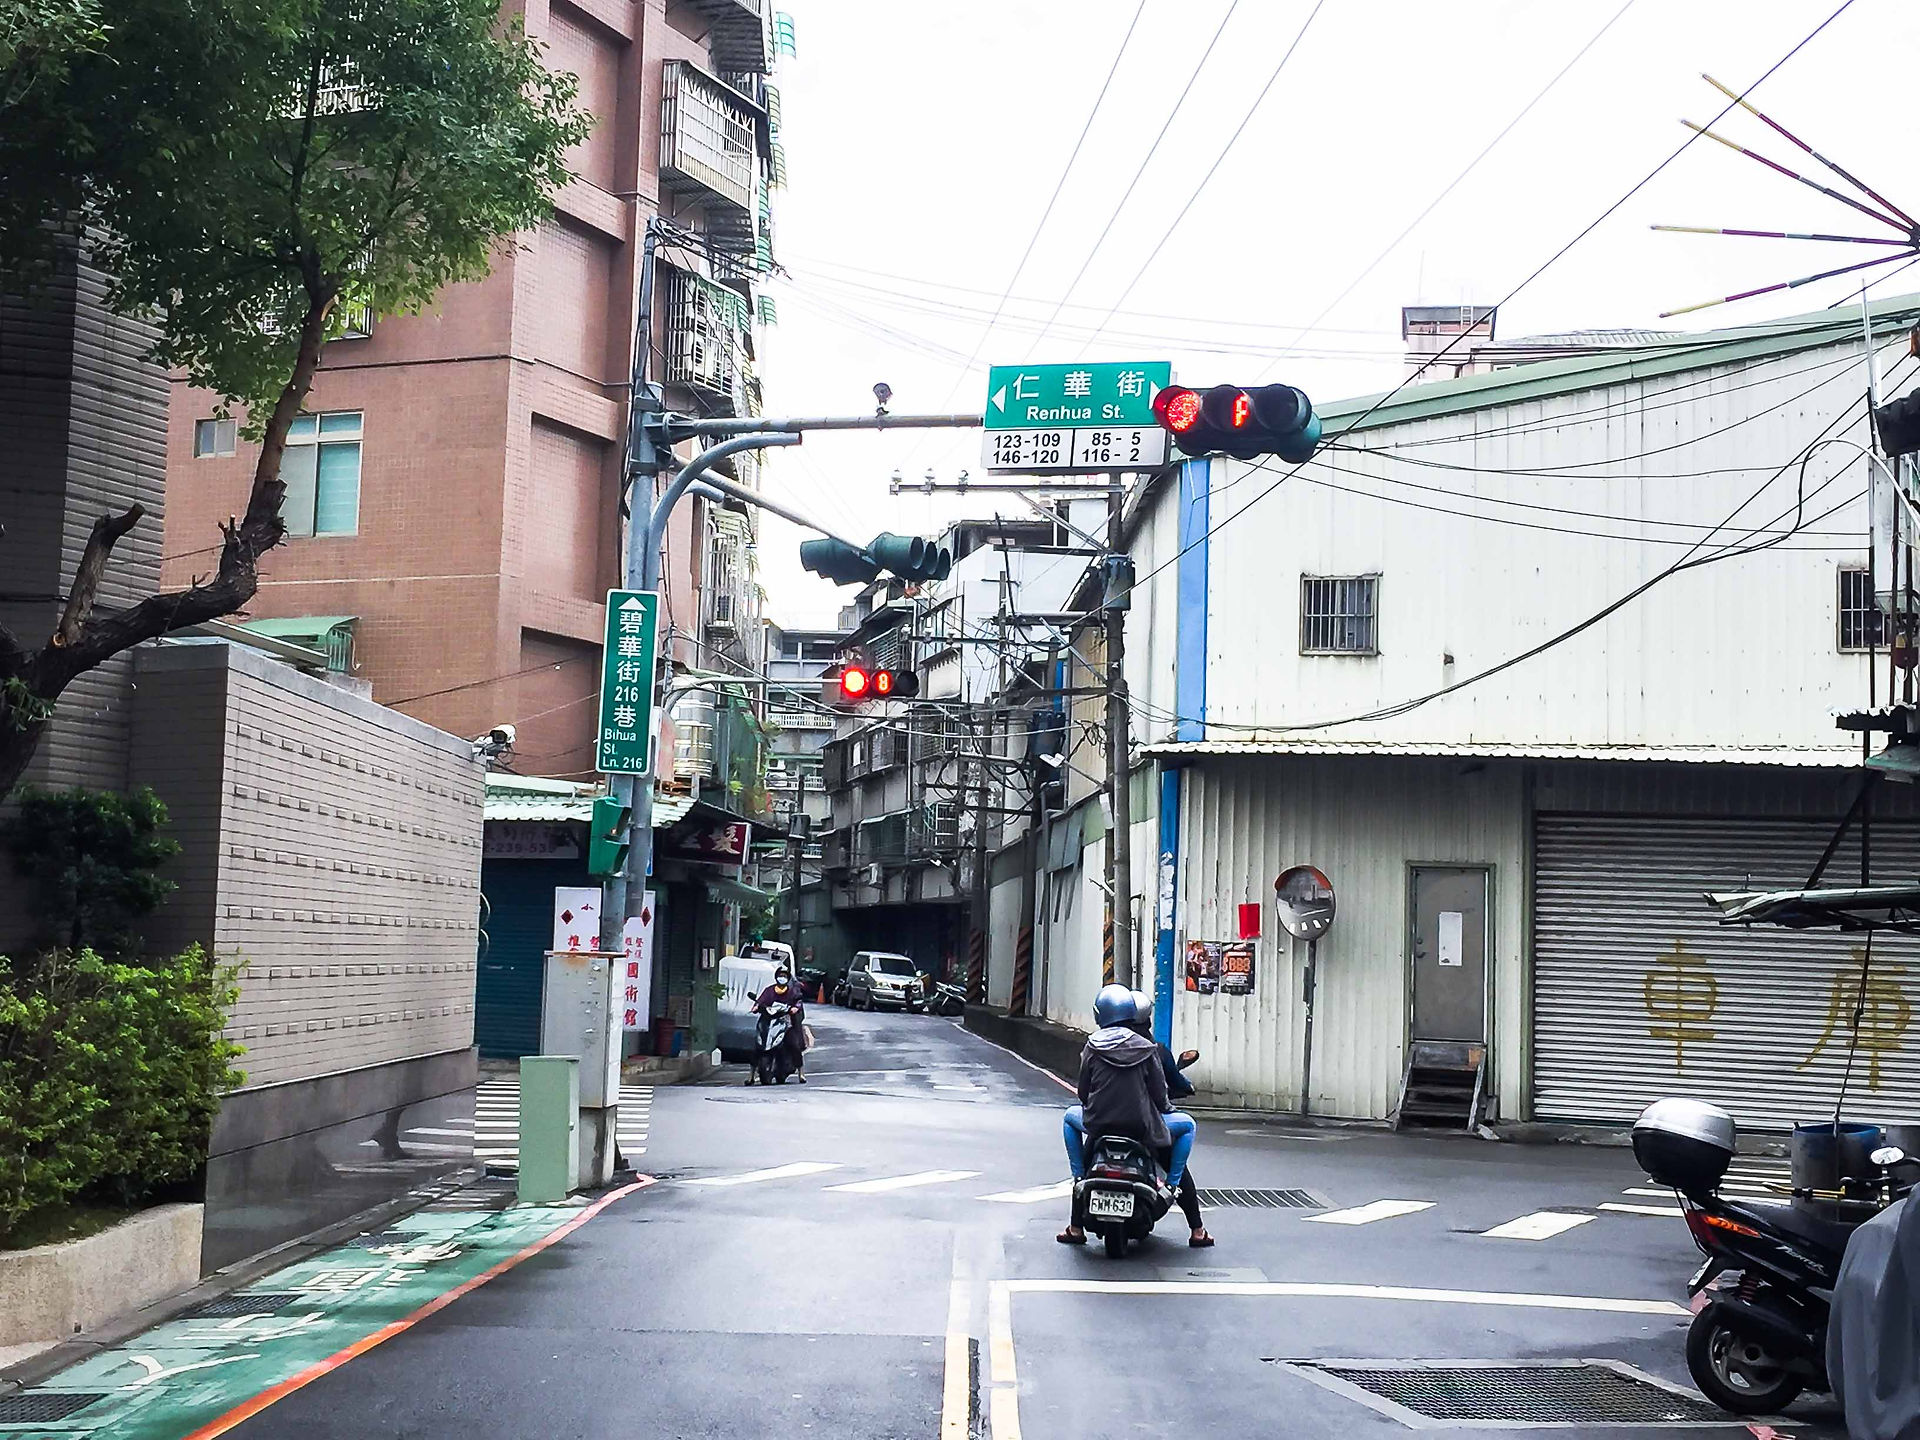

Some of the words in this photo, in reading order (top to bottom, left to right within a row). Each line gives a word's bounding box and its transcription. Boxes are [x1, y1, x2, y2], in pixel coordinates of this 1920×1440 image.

[1012, 370, 1146, 401] 仁華街
[1026, 405, 1092, 421] Renhua
[1101, 403, 1125, 419] St.
[993, 433, 1061, 449] 123-109
[992, 449, 1060, 465] 146-120
[604, 728, 637, 742] Bihua
[603, 742, 618, 755] St.
[602, 756, 619, 768] Ln.
[622, 756, 643, 769] 216
